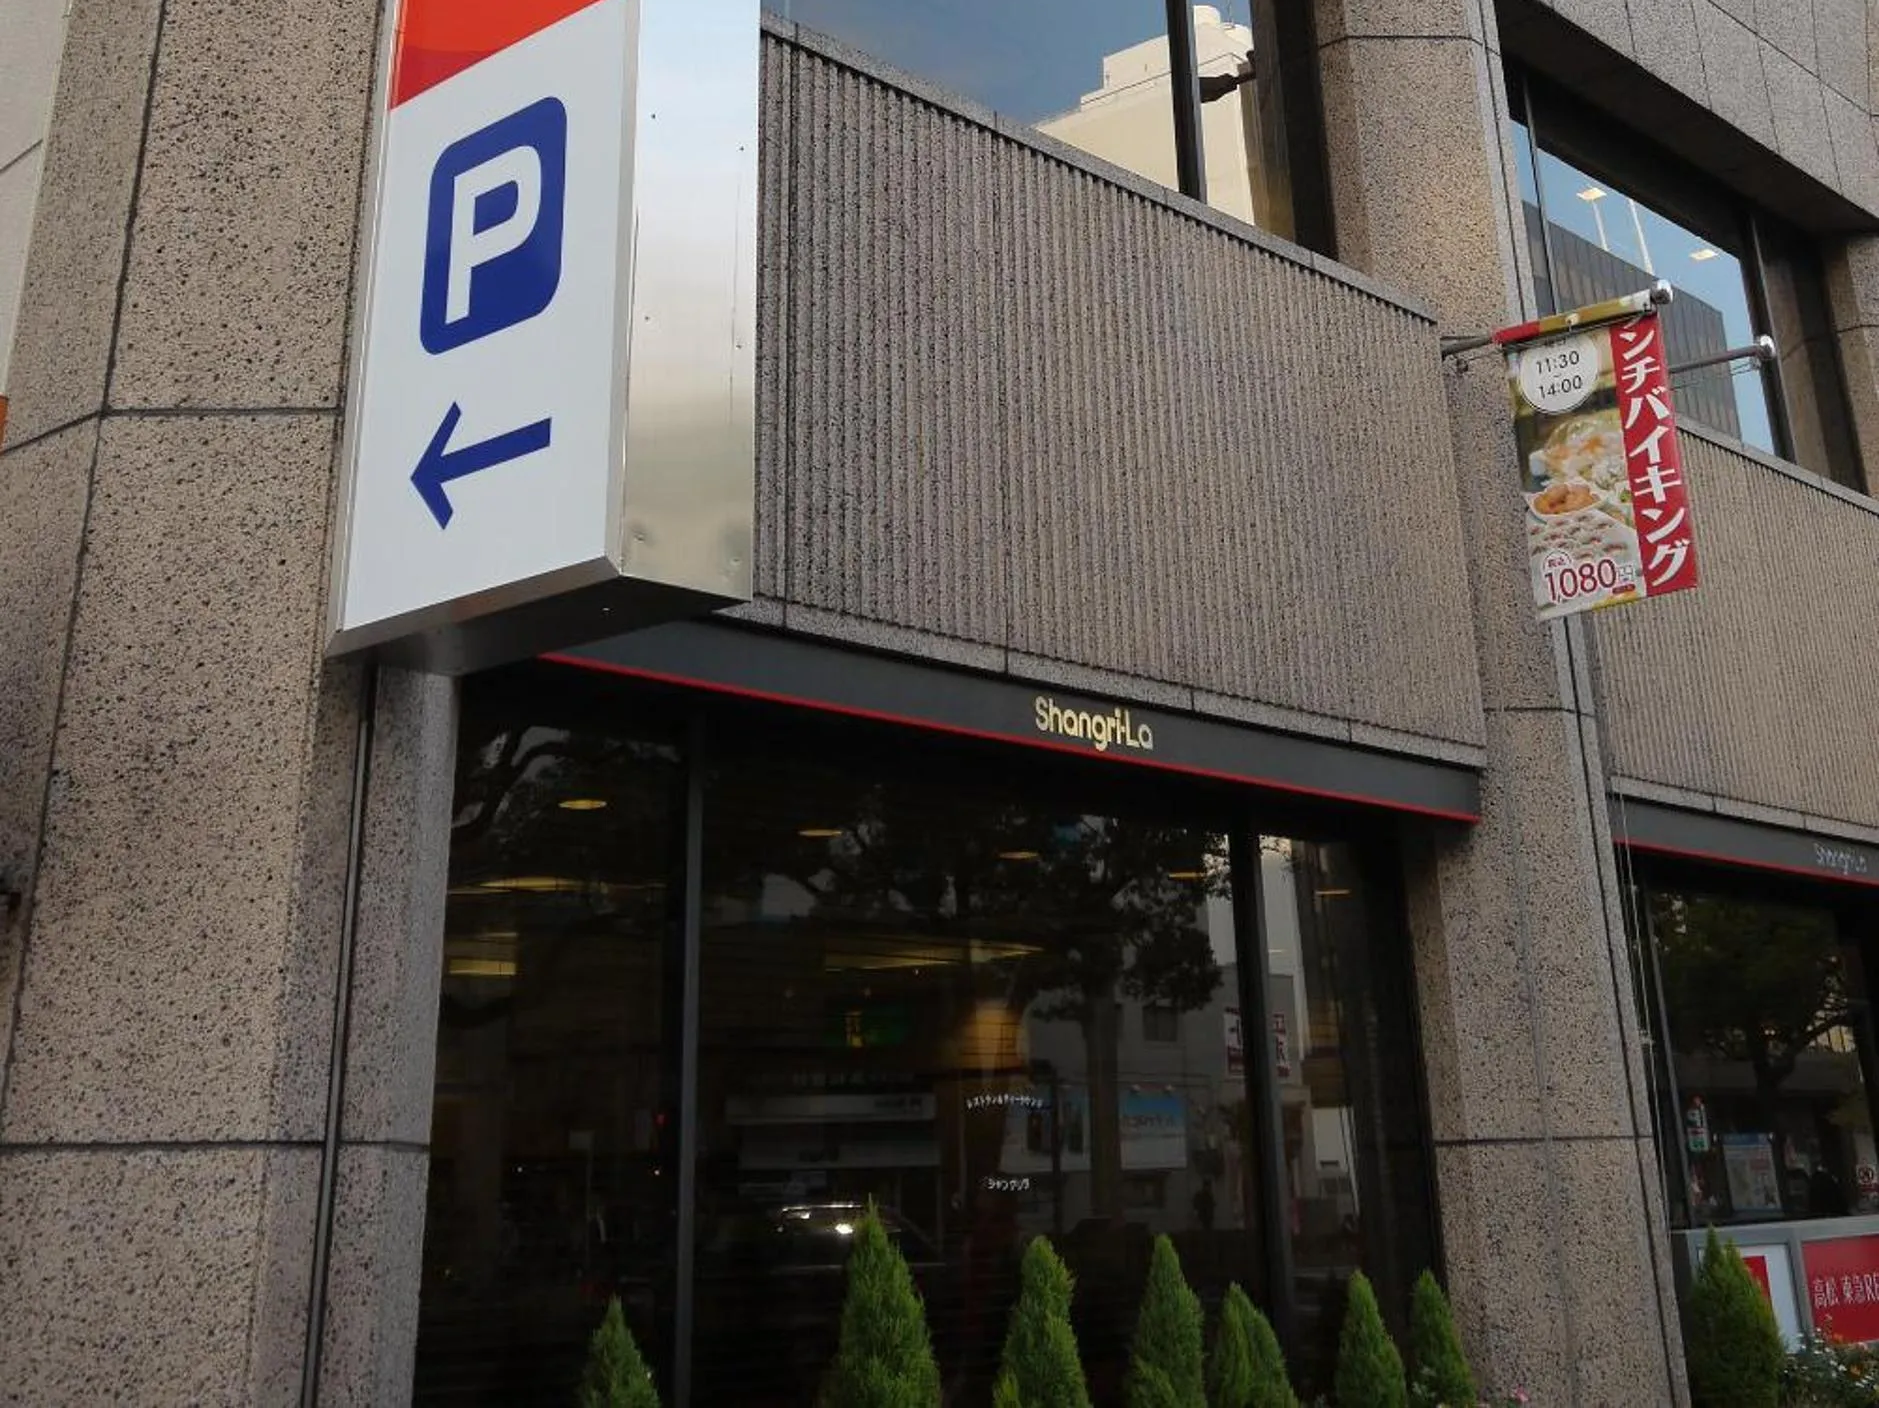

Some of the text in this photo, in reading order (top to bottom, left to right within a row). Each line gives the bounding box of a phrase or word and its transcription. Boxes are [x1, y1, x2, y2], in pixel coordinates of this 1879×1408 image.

[445, 144, 542, 325] P
[1536, 350, 1580, 375] 11:30
[1538, 374, 1583, 399] 14:00
[1617, 316, 1691, 587] ンチバイキング
[1035, 695, 1153, 751] Shangri-La
